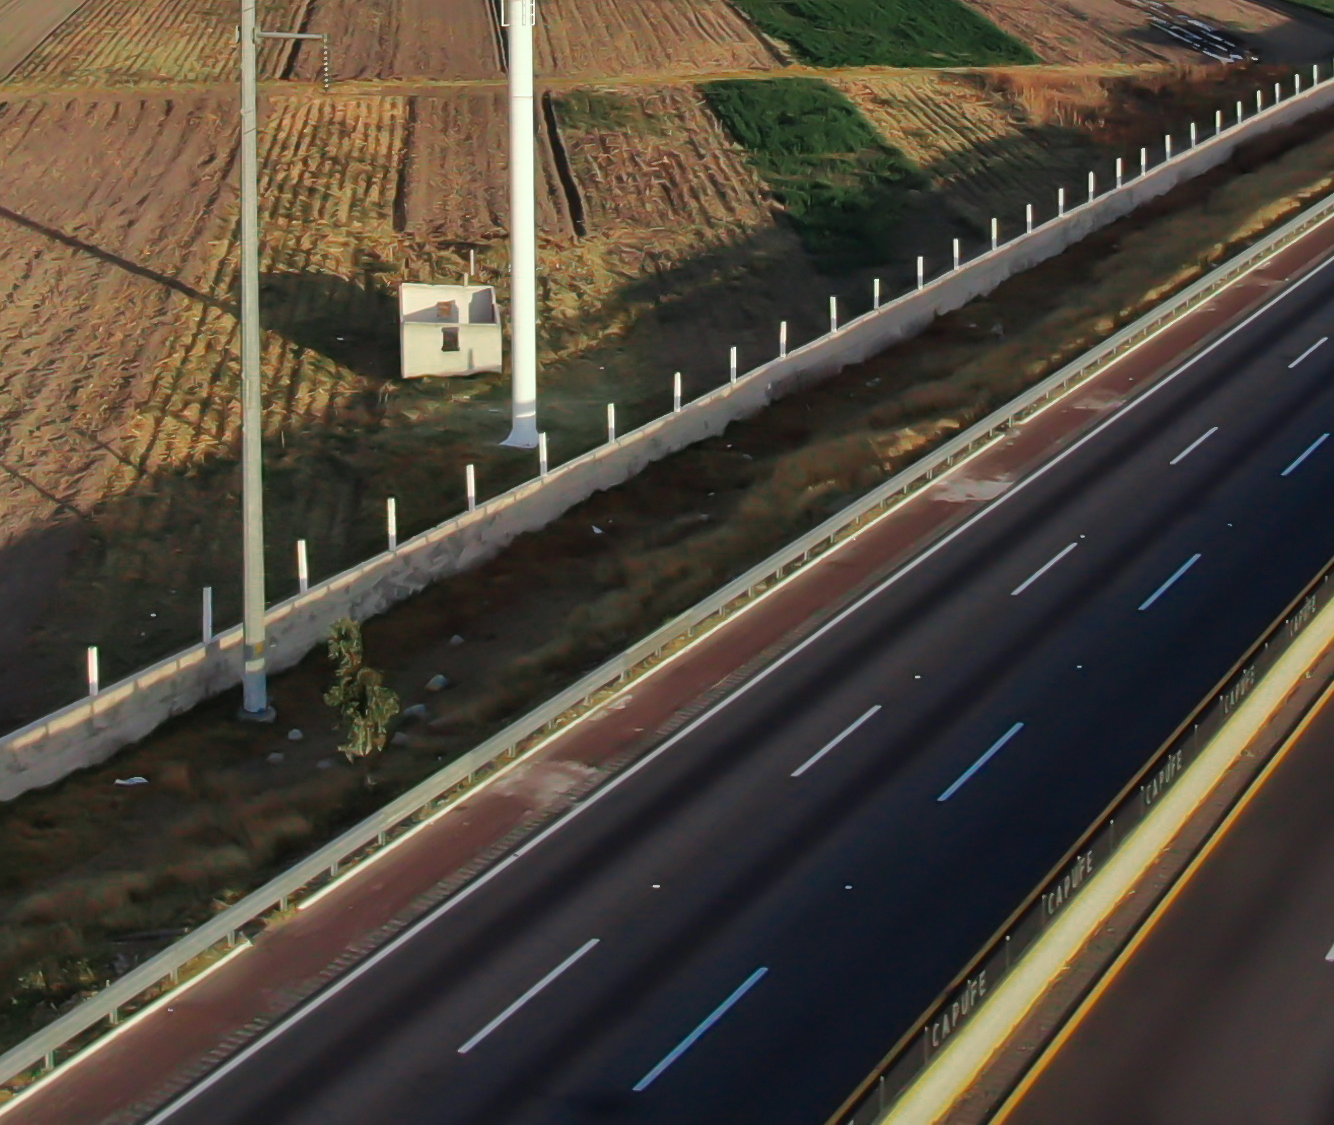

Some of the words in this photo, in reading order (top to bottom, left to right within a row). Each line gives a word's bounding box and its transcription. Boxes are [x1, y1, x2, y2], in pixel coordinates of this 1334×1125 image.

[1145, 749, 1183, 805] CAPUFE
[1047, 850, 1093, 915] CAPUFE
[932, 969, 987, 1047] CAPUFE
